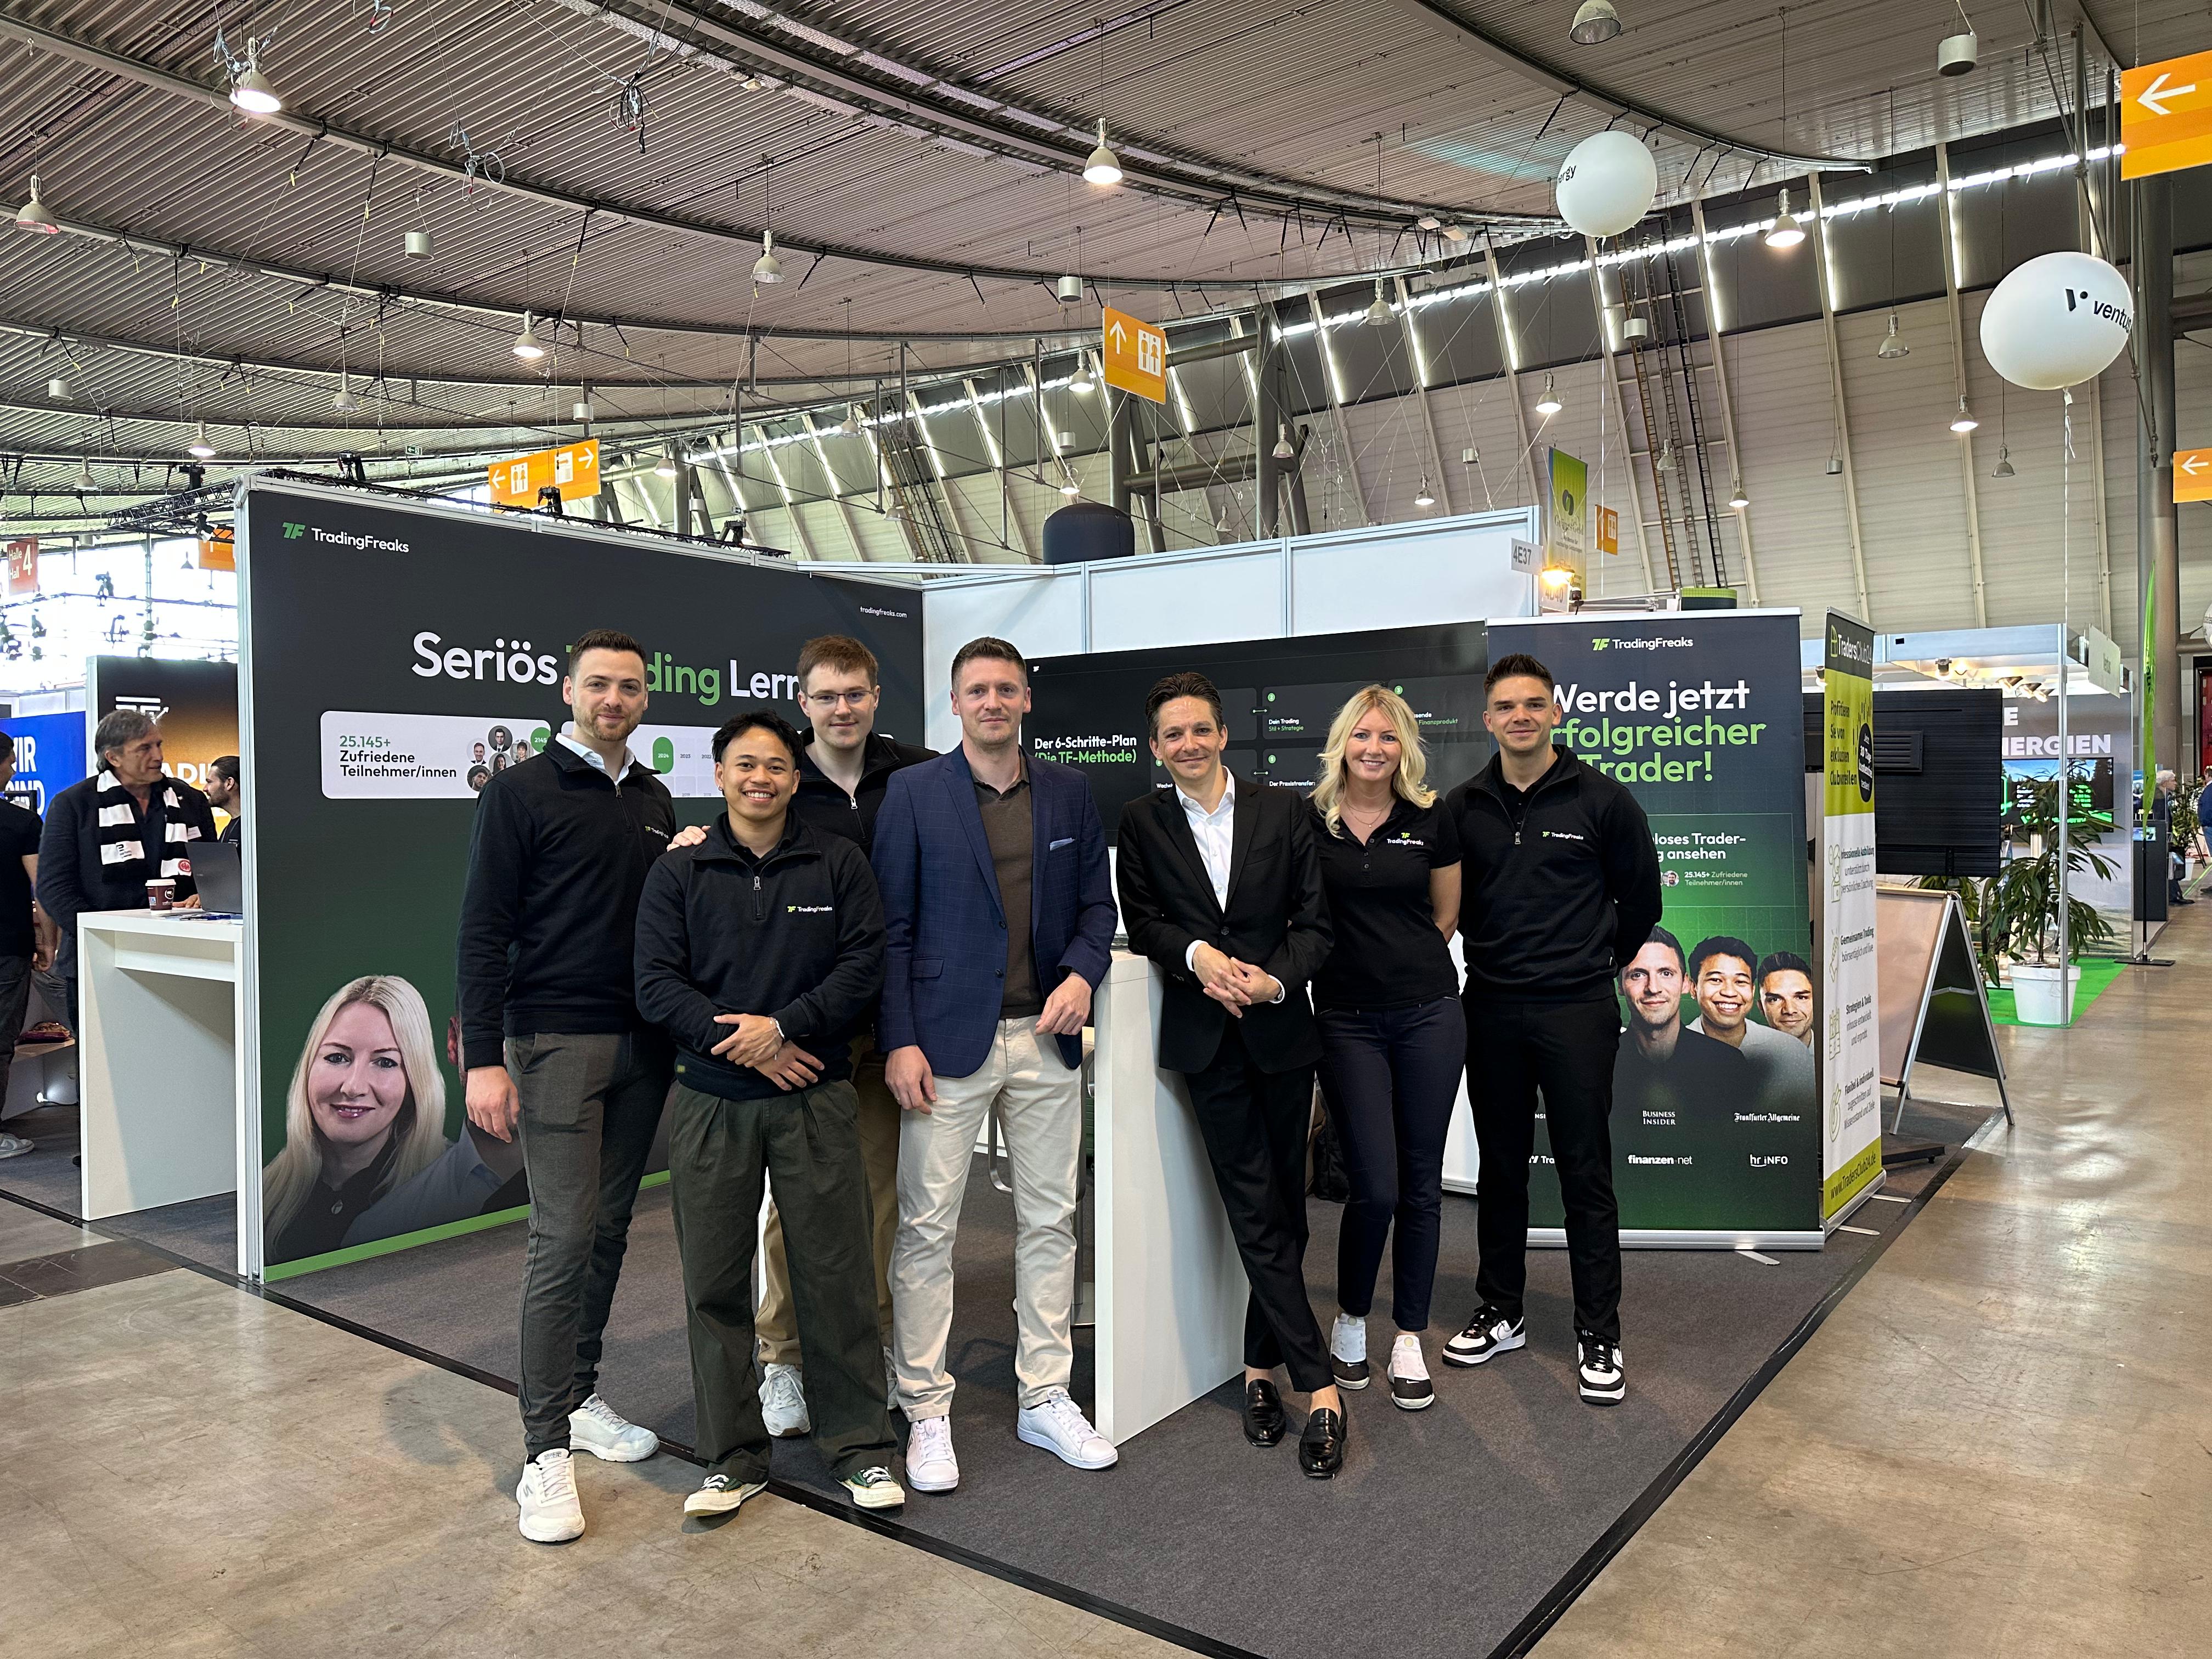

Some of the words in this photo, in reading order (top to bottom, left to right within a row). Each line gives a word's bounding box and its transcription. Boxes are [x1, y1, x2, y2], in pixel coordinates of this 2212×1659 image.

[311, 528, 409, 553] TradingFreaks
[9, 547, 22, 561] Halle
[22, 544, 32, 575] 4
[1513, 545, 1532, 566] 4E37
[9, 566, 19, 579] Hall
[860, 606, 907, 618] tradingfreaks.com
[1612, 636, 1694, 651] TradingFreaks
[411, 631, 558, 685] Seriös
[1554, 681, 1660, 713] Werde
[1662, 680, 1750, 719] jetzt
[1419, 718, 1458, 726] Finanzprodukt
[2004, 707, 2018, 726] E
[340, 735, 391, 748] 25.145+
[1035, 738, 1053, 749] Der
[1055, 734, 1137, 748] 6-Schritte-Plan
[340, 750, 415, 763] Zufriedene
[1058, 748, 1137, 763] TF-Methode)
[340, 765, 456, 778] Teilnehmer/innen
[1577, 751, 1713, 783] Trader!
[1691, 832, 1746, 845] Trader-
[1667, 847, 1726, 860] ansehen
[1643, 1110, 1675, 1118] BUSINESS
[1767, 1112, 1800, 1123] Allgemeine
[1750, 1154, 1762, 1165] hr
[1831, 1151, 1876, 1200] www.TradersClub24.de
